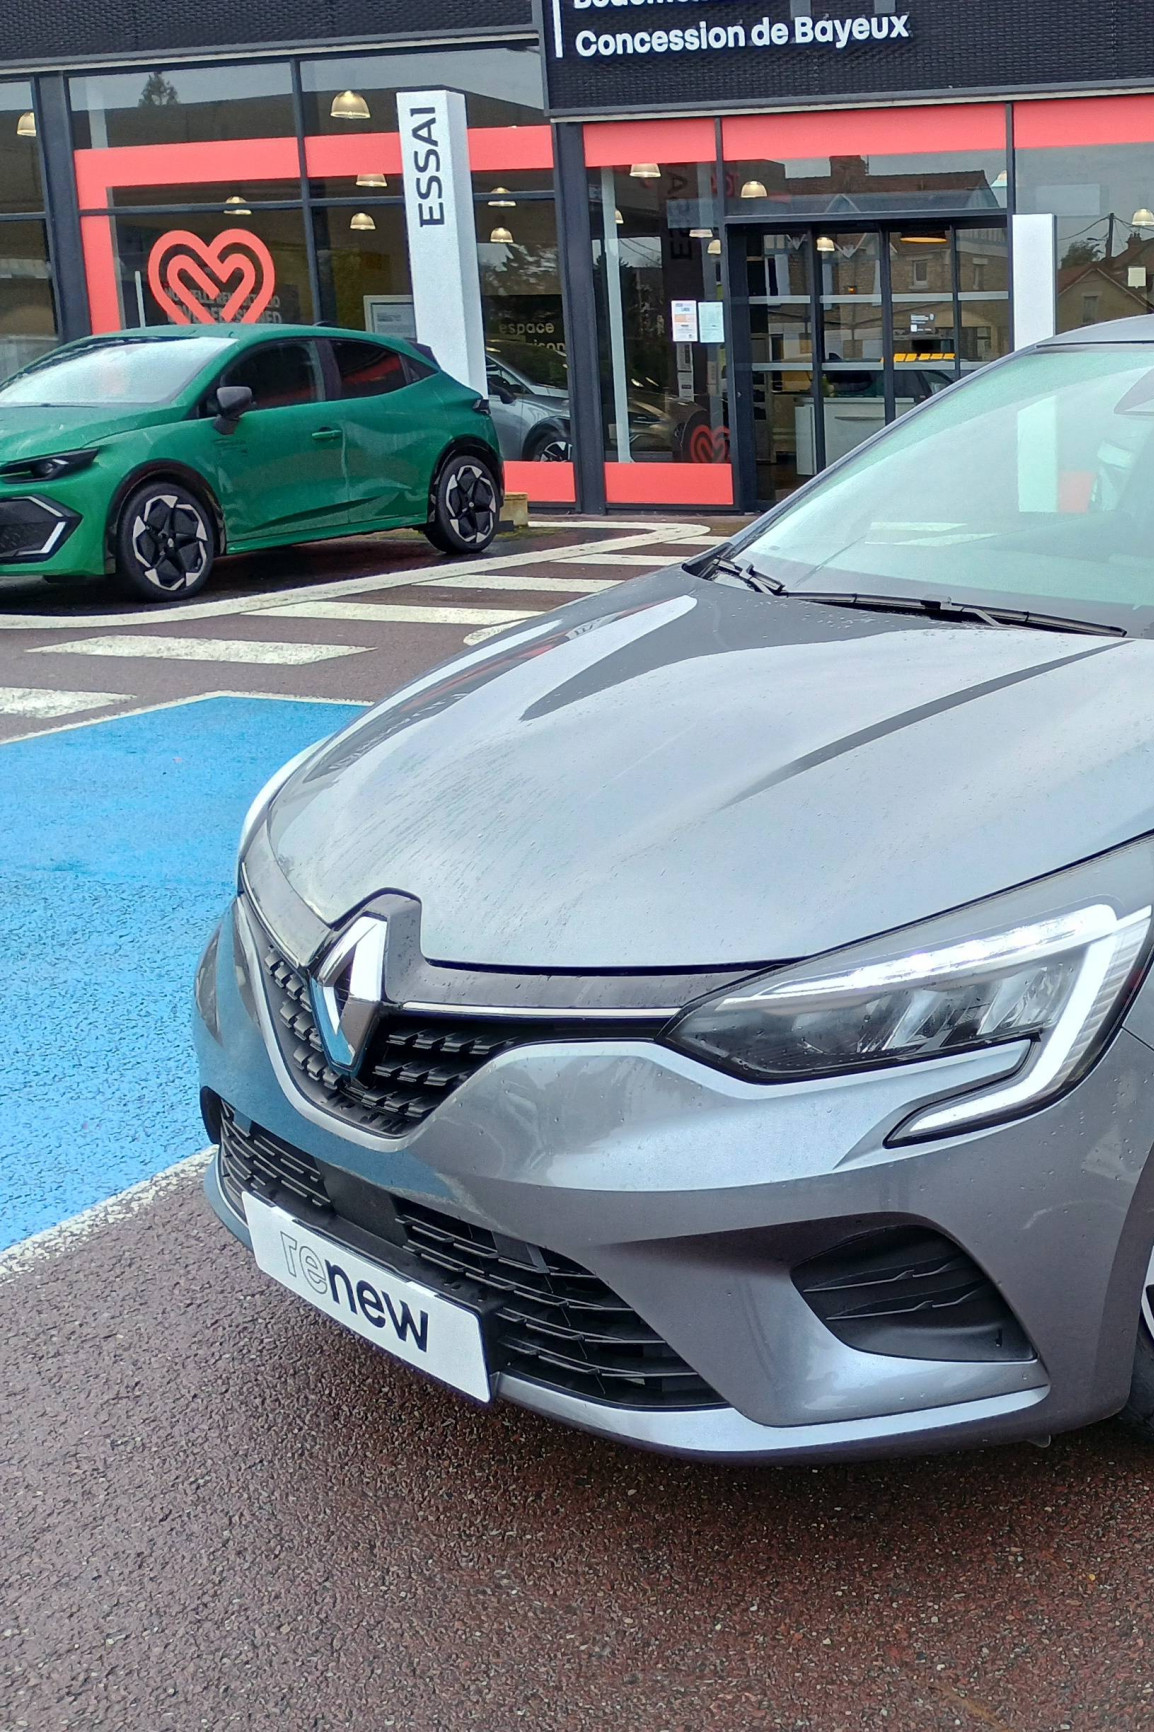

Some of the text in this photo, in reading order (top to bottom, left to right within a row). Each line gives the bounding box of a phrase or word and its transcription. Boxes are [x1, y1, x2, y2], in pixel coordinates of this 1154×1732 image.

[575, 14, 910, 58] Concession de Bayeux
[409, 106, 445, 228] ESSAI
[499, 322, 555, 337] espace
[280, 1230, 429, 1353] renew
